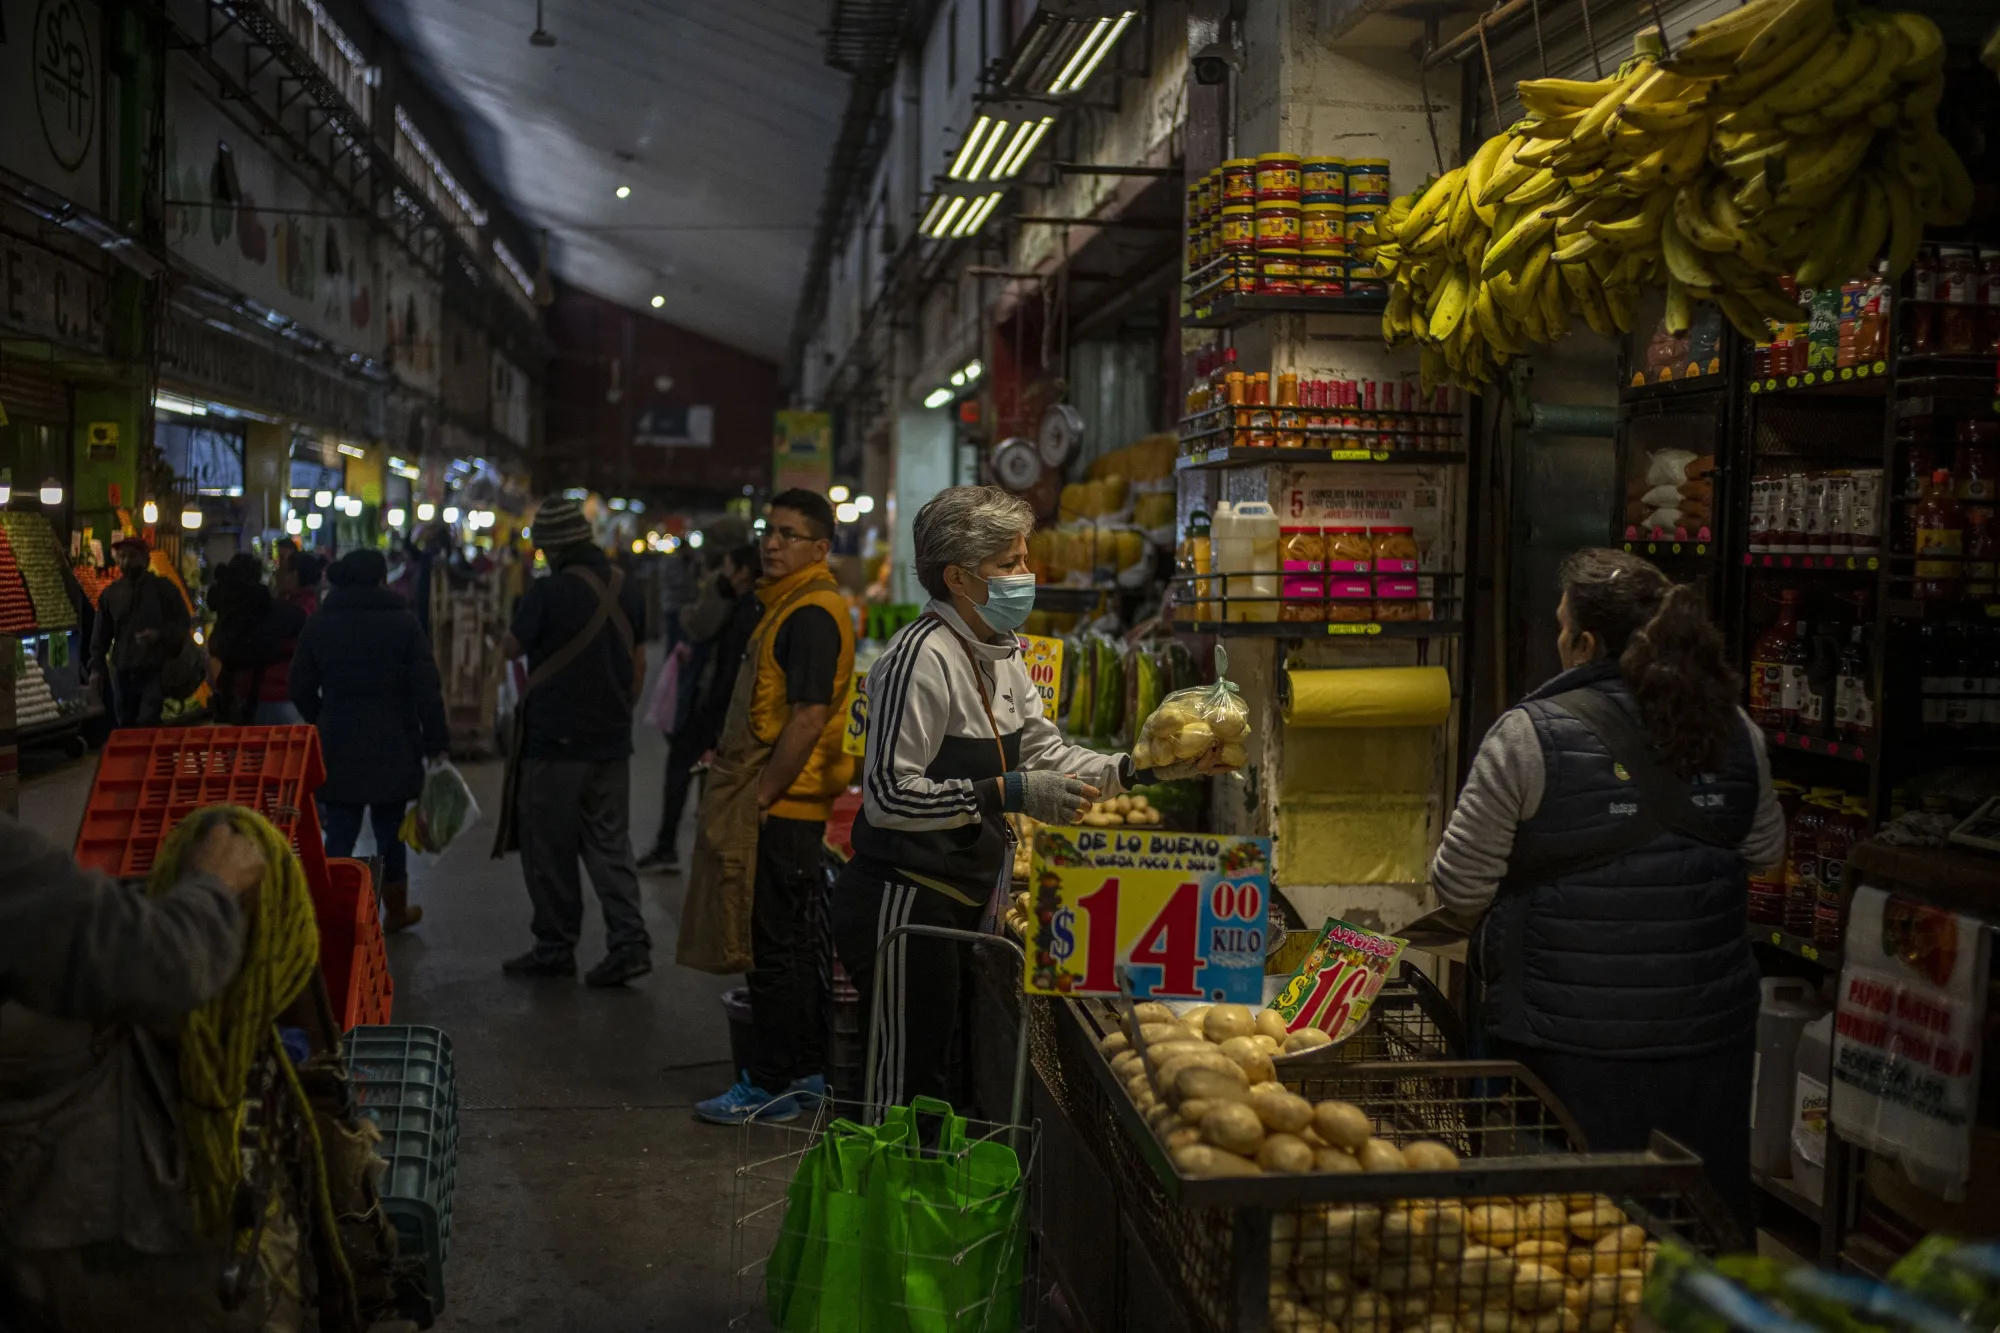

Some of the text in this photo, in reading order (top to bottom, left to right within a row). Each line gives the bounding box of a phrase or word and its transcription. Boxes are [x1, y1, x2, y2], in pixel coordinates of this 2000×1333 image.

[1290, 490, 1304, 519] 5
[1310, 488, 1345, 499] CONSEJOS
[1346, 489, 1364, 499] PARA
[1365, 501, 1403, 509] INFLUENZA
[1031, 663, 1054, 684] 00
[848, 697, 867, 740] $
[1078, 833, 1220, 856] DE LO BUENO
[1052, 877, 1260, 997] $ 14 00
[1211, 929, 1261, 953] KILO
[1277, 976, 1309, 1007] $
[1286, 960, 1368, 1040] 16
